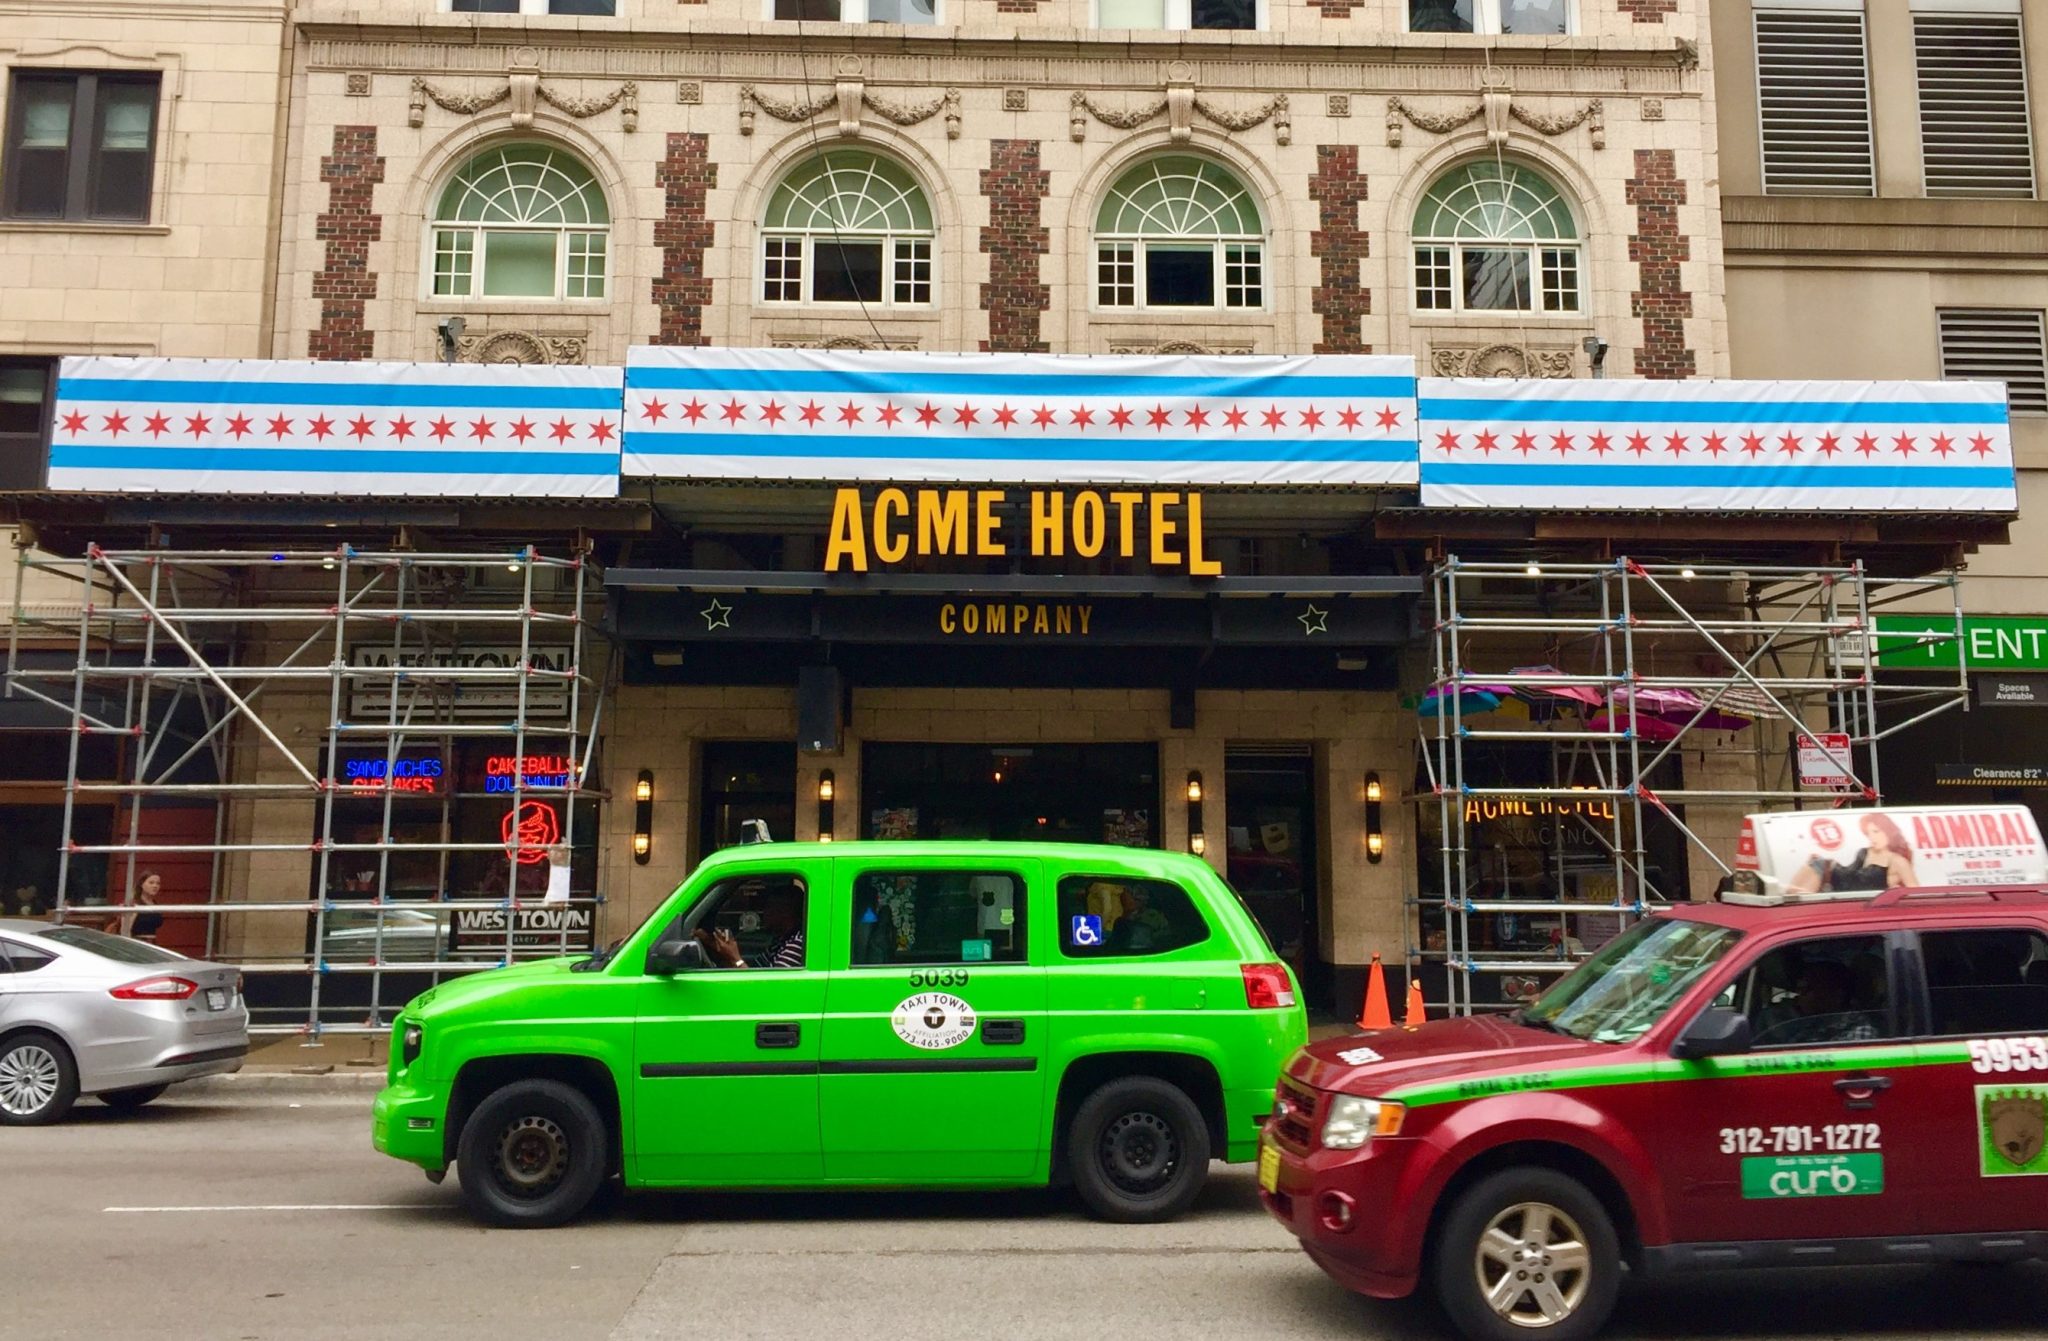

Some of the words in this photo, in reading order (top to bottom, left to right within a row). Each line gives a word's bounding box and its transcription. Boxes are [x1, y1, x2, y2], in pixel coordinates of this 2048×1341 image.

[824, 488, 1006, 572] ACME
[1031, 489, 1222, 576] HOTEL
[940, 603, 1093, 634] COMPANY
[1996, 692, 2034, 700] Available
[1998, 683, 2030, 692] Spaces
[1973, 768, 2022, 778] Clearance
[1912, 813, 2035, 849] ADMIRAL
[519, 909, 590, 929] TOWN
[909, 968, 969, 988] 5039
[901, 995, 927, 1012] TAXI
[933, 994, 968, 1013] TOWN
[899, 1029, 969, 1048] 773-465-9000
[1719, 1123, 1882, 1154] 312-791-1272
[1769, 1165, 1857, 1195] curb
